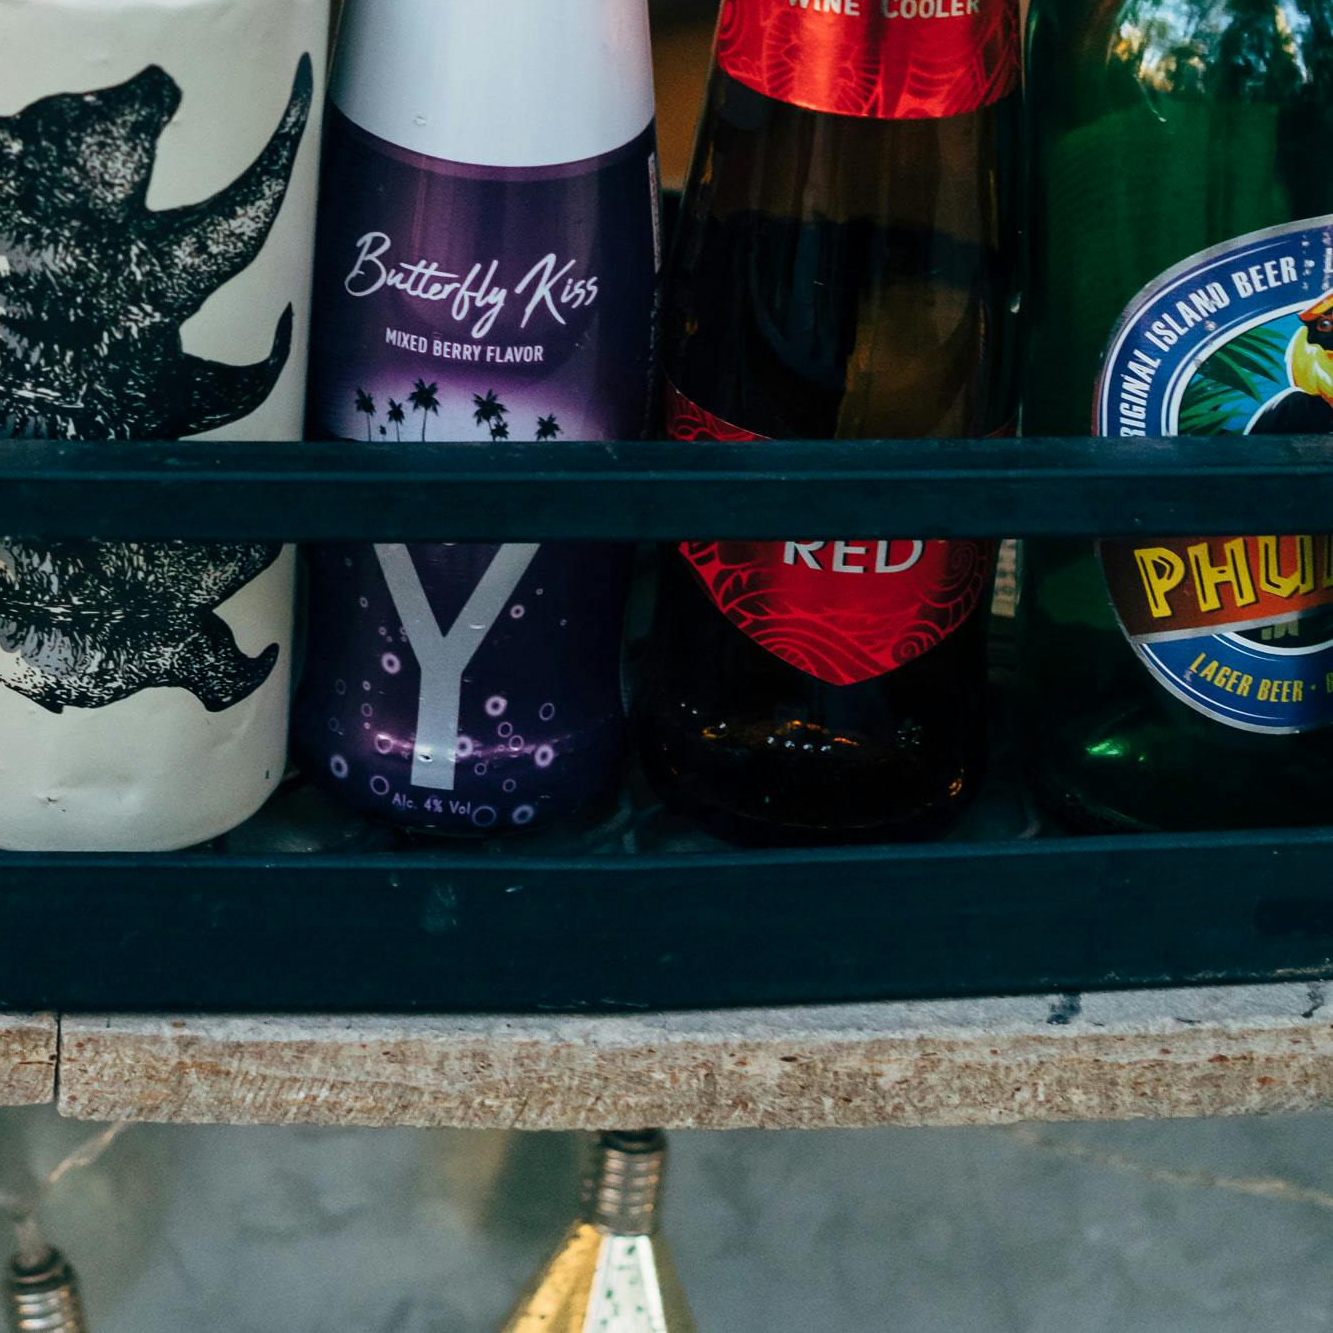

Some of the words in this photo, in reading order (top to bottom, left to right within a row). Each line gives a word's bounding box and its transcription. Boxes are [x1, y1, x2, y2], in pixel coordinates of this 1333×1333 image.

[344, 231, 509, 339] Butterfly
[514, 252, 599, 330] Kiss
[384, 326, 429, 355] MIXED
[432, 339, 483, 363] BERRY
[486, 344, 545, 364] FLAVOR
[1118, 348, 1163, 438] RIGINAL
[1144, 280, 1232, 352] ISLAND
[1229, 255, 1299, 300] BEER
[1133, 535, 1333, 619] PHU
[1188, 651, 1255, 698] LAGER
[1256, 677, 1305, 704] BEER
[423, 796, 444, 814] 4%
